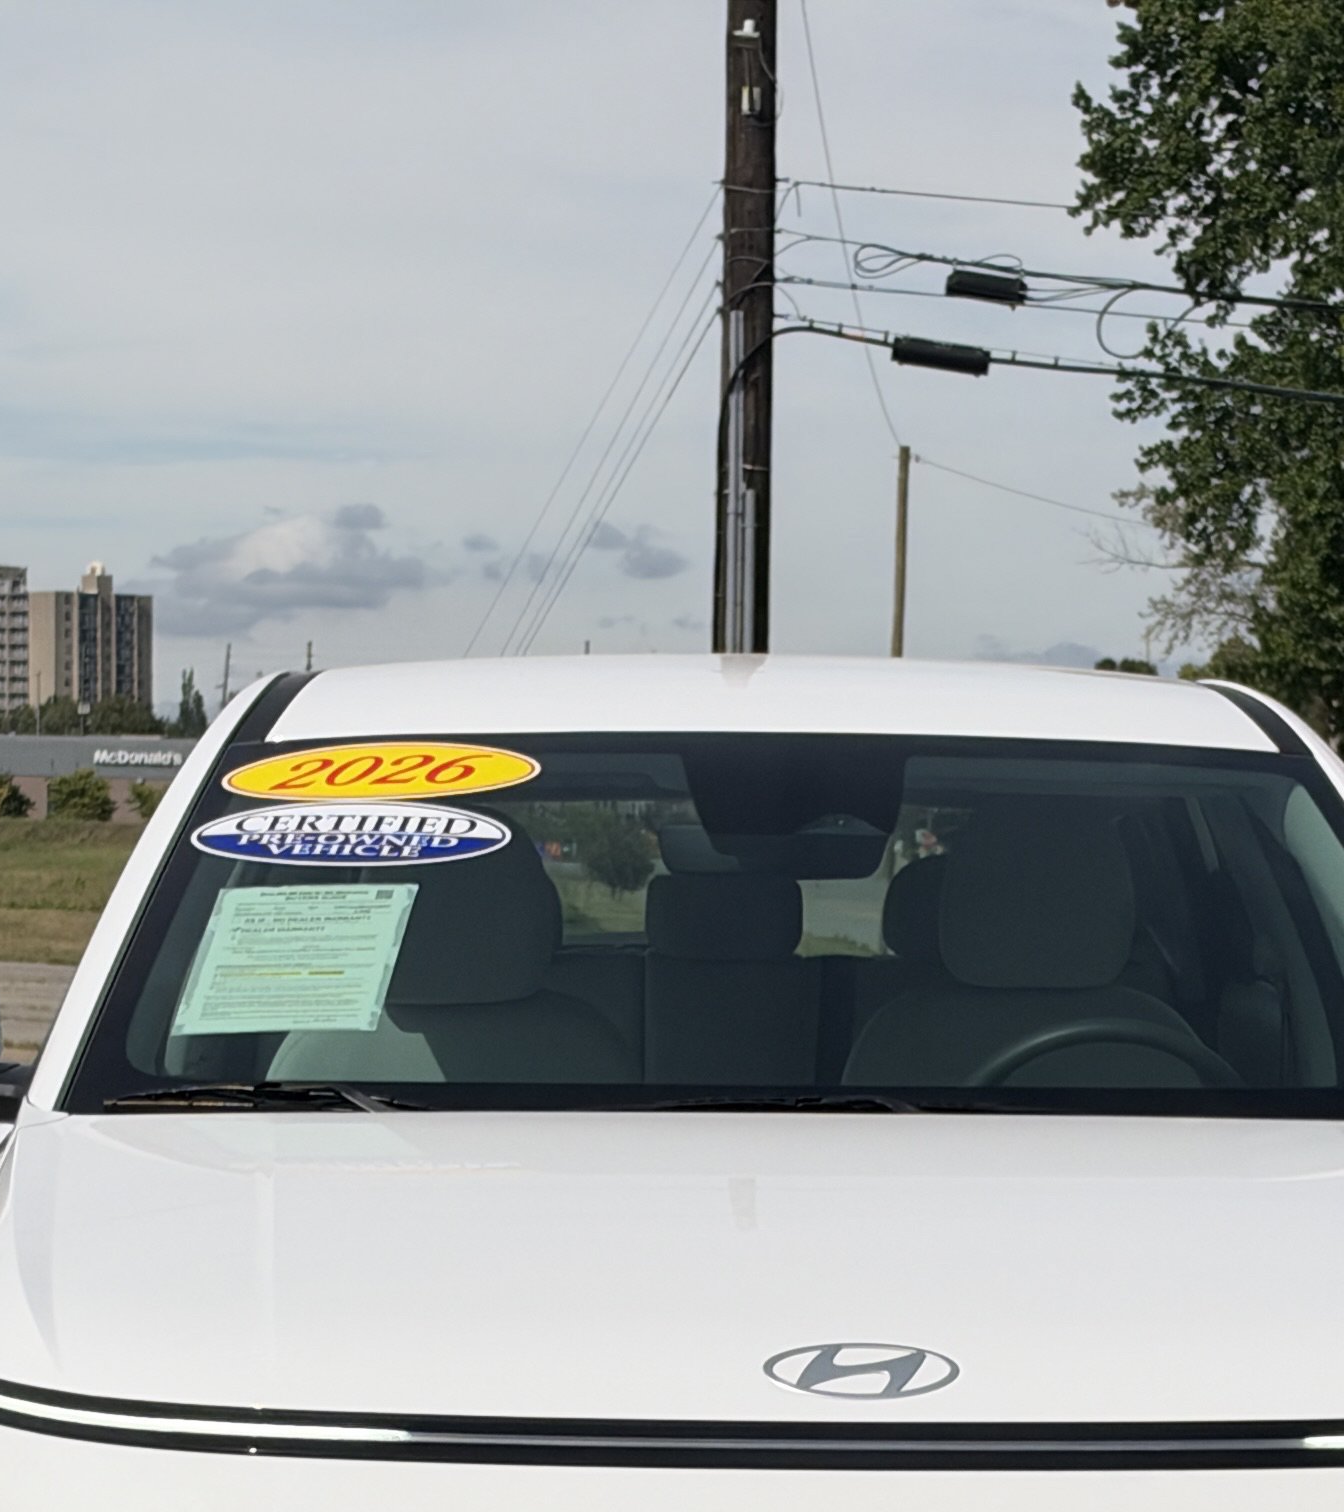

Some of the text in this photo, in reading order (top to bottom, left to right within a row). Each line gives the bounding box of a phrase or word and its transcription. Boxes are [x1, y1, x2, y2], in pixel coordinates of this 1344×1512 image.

[93, 749, 182, 766] McDonald's
[268, 754, 494, 791] 2026
[235, 814, 478, 835] CERTIFIED
[236, 832, 459, 848] PRE-OWNED
[266, 843, 420, 858] VEHICLE
